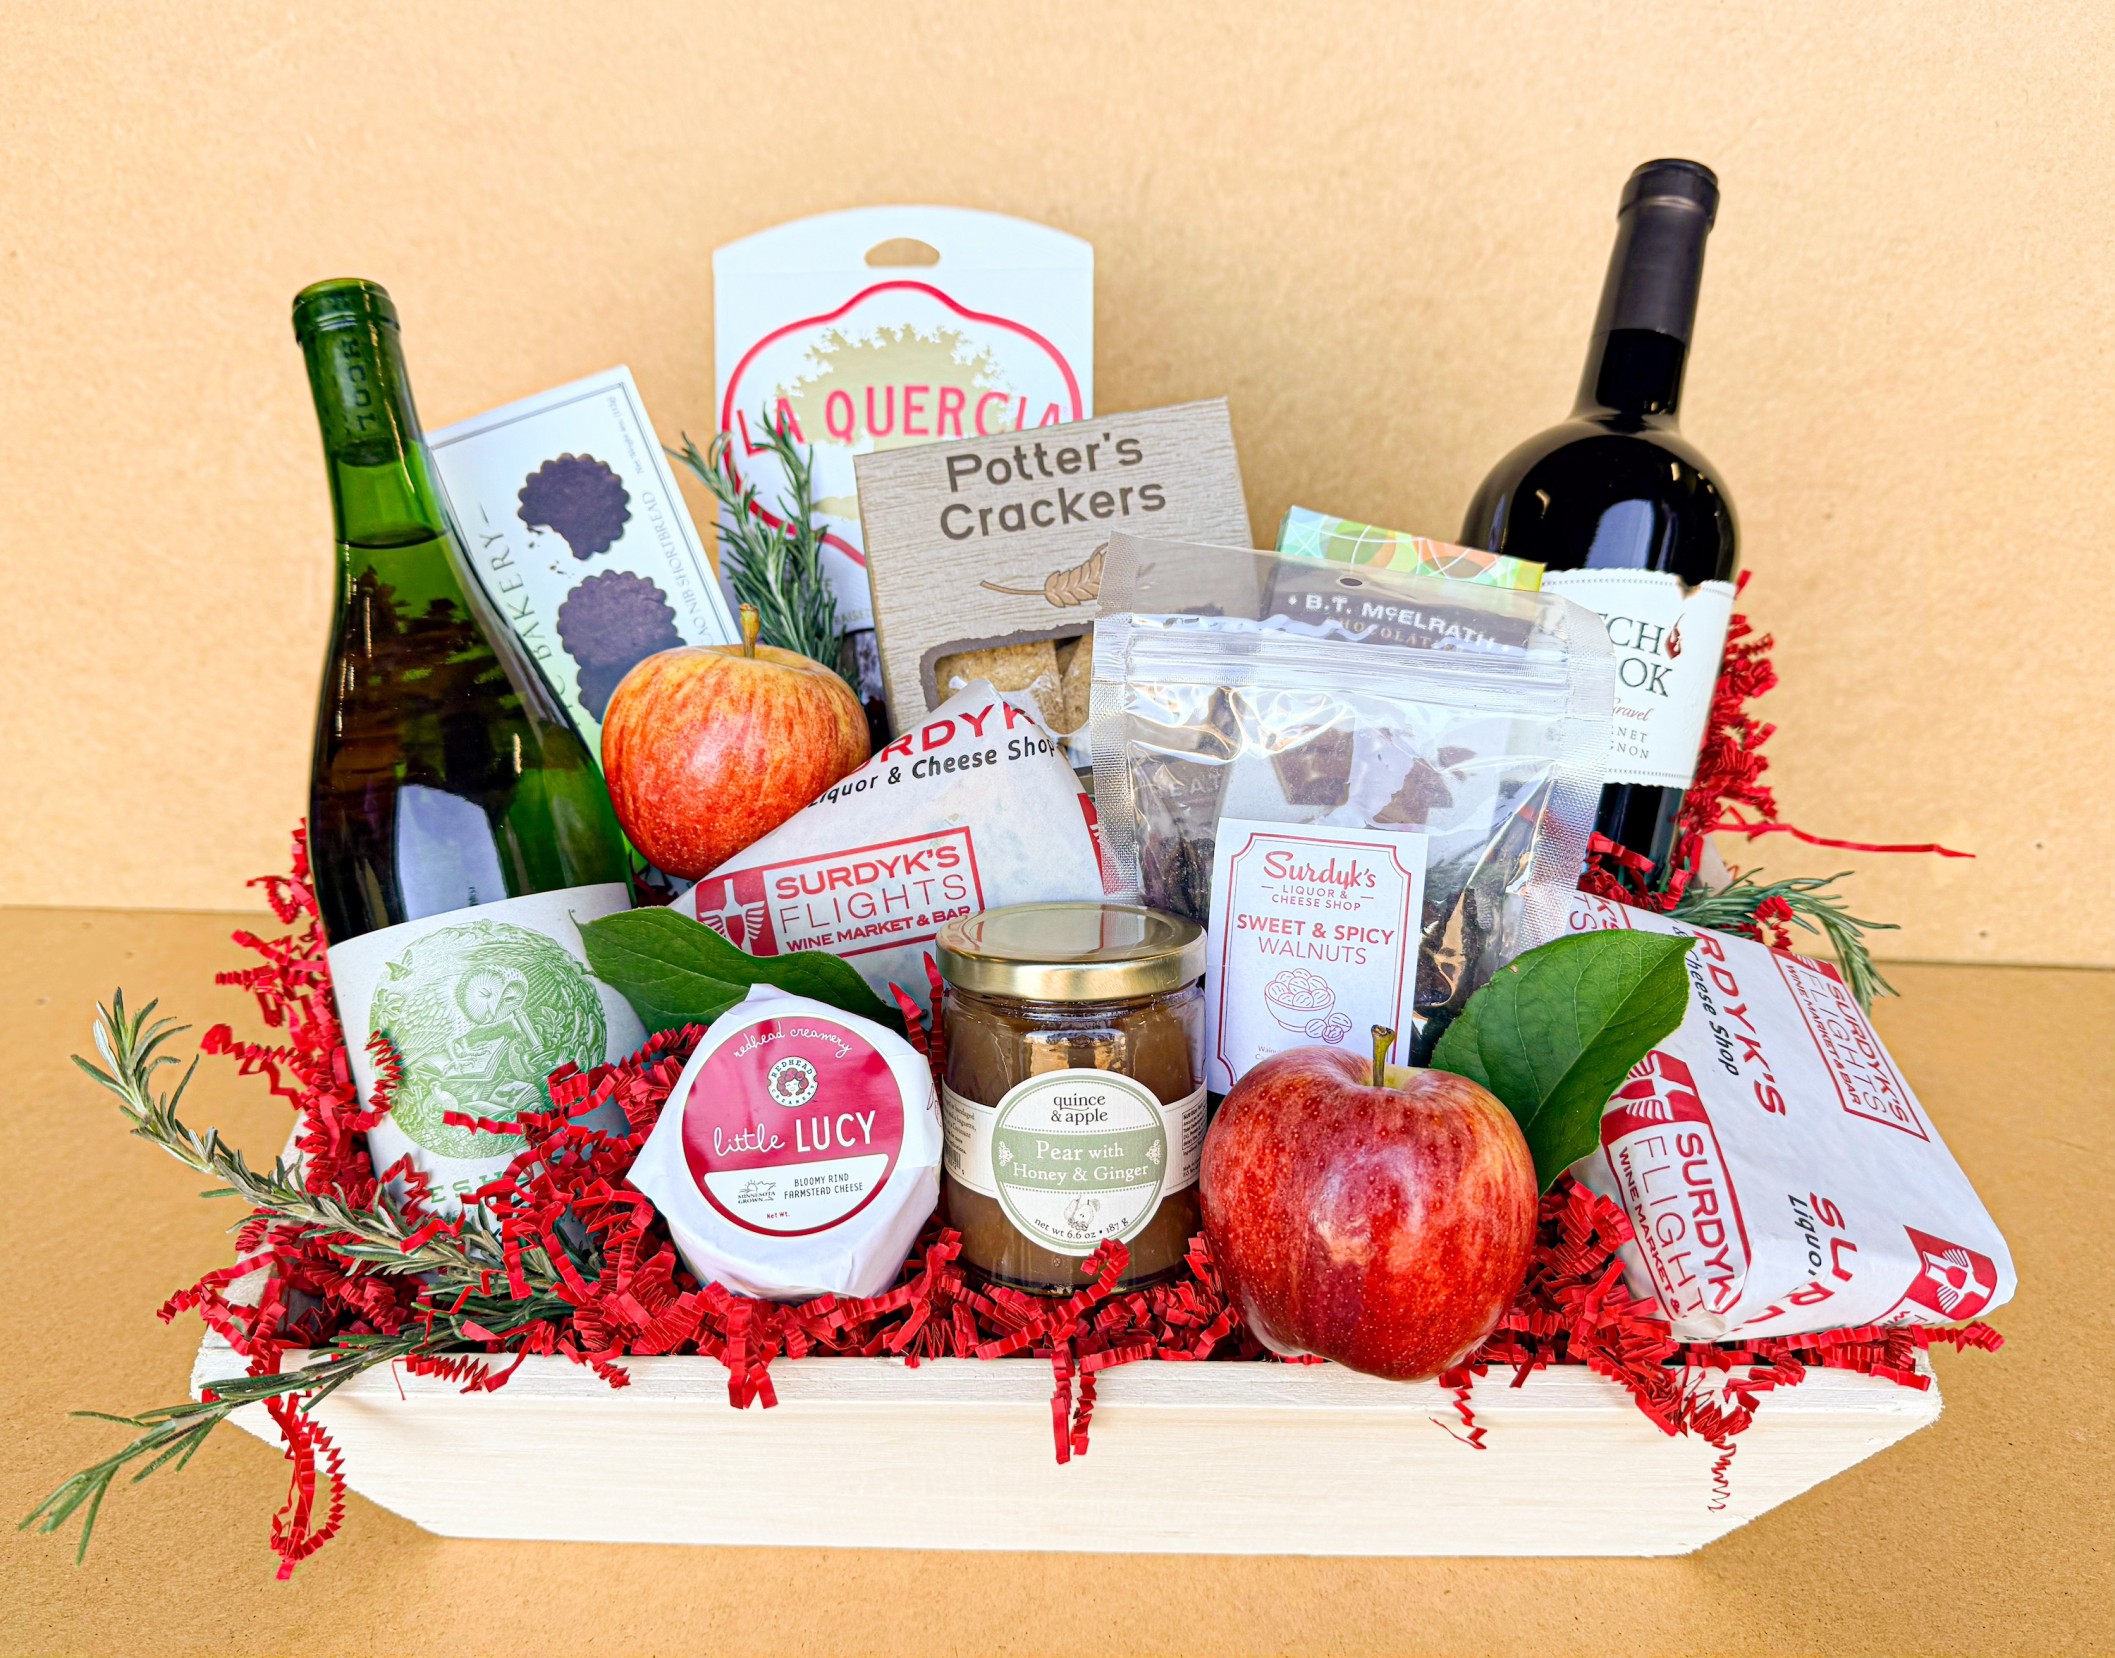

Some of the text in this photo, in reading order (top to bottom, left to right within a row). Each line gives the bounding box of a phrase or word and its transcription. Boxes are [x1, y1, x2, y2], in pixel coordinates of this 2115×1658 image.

[736, 396, 805, 457] LA
[946, 433, 1143, 492] Potter's
[940, 482, 1166, 540] Crackers
[642, 490, 687, 595] SHORTBREAD
[479, 531, 552, 661] BAKERY
[681, 592, 701, 619] NIB
[1305, 593, 1352, 616] B.T.
[1620, 657, 1672, 698] OK
[852, 701, 1035, 775] RDYK
[1610, 740, 1649, 760] NON
[1611, 726, 1648, 743] NET
[888, 766, 901, 785] &
[912, 749, 997, 779] Cheese
[1008, 735, 1056, 761] Shop
[775, 844, 960, 899] SURDYK'S
[1263, 850, 1377, 890] Surdyk's
[779, 873, 967, 934] FLIGHTS
[1271, 893, 1361, 912] CHEESE SHOP
[1282, 884, 1348, 900] LIQUOR &
[787, 905, 971, 952] WINE MARKET & BAR
[1236, 913, 1395, 945] SWEET & SPICY
[1257, 936, 1367, 965] WALNUTS
[733, 1021, 852, 1059] redhead creamery
[1692, 929, 1787, 1117] RDYK'S
[1786, 964, 1862, 1106] WINE MARKET & BAR
[1800, 969, 1888, 1114] FLIGHTS
[1709, 1020, 1740, 1076] Shop
[1826, 982, 1910, 1124] SURDYK'S
[771, 1059, 812, 1078] REDHEAD
[1051, 1108, 1109, 1126] & apple
[1053, 1093, 1106, 1111] quince
[713, 1110, 876, 1157] little LUCY
[1036, 1140, 1125, 1162] Pear with
[784, 1182, 864, 1200] FARMSTEAD CHEESE
[794, 1173, 849, 1187] BLOOMY RIND
[1013, 1163, 1149, 1189] Honey & Ginger
[1034, 1217, 1049, 1231] net
[1052, 1227, 1064, 1238] wt
[1066, 1228, 1082, 1240] 6.6
[1084, 1230, 1096, 1239] oz
[1121, 1217, 1129, 1229] g
[1619, 1146, 1680, 1314] WINE MARKET &
